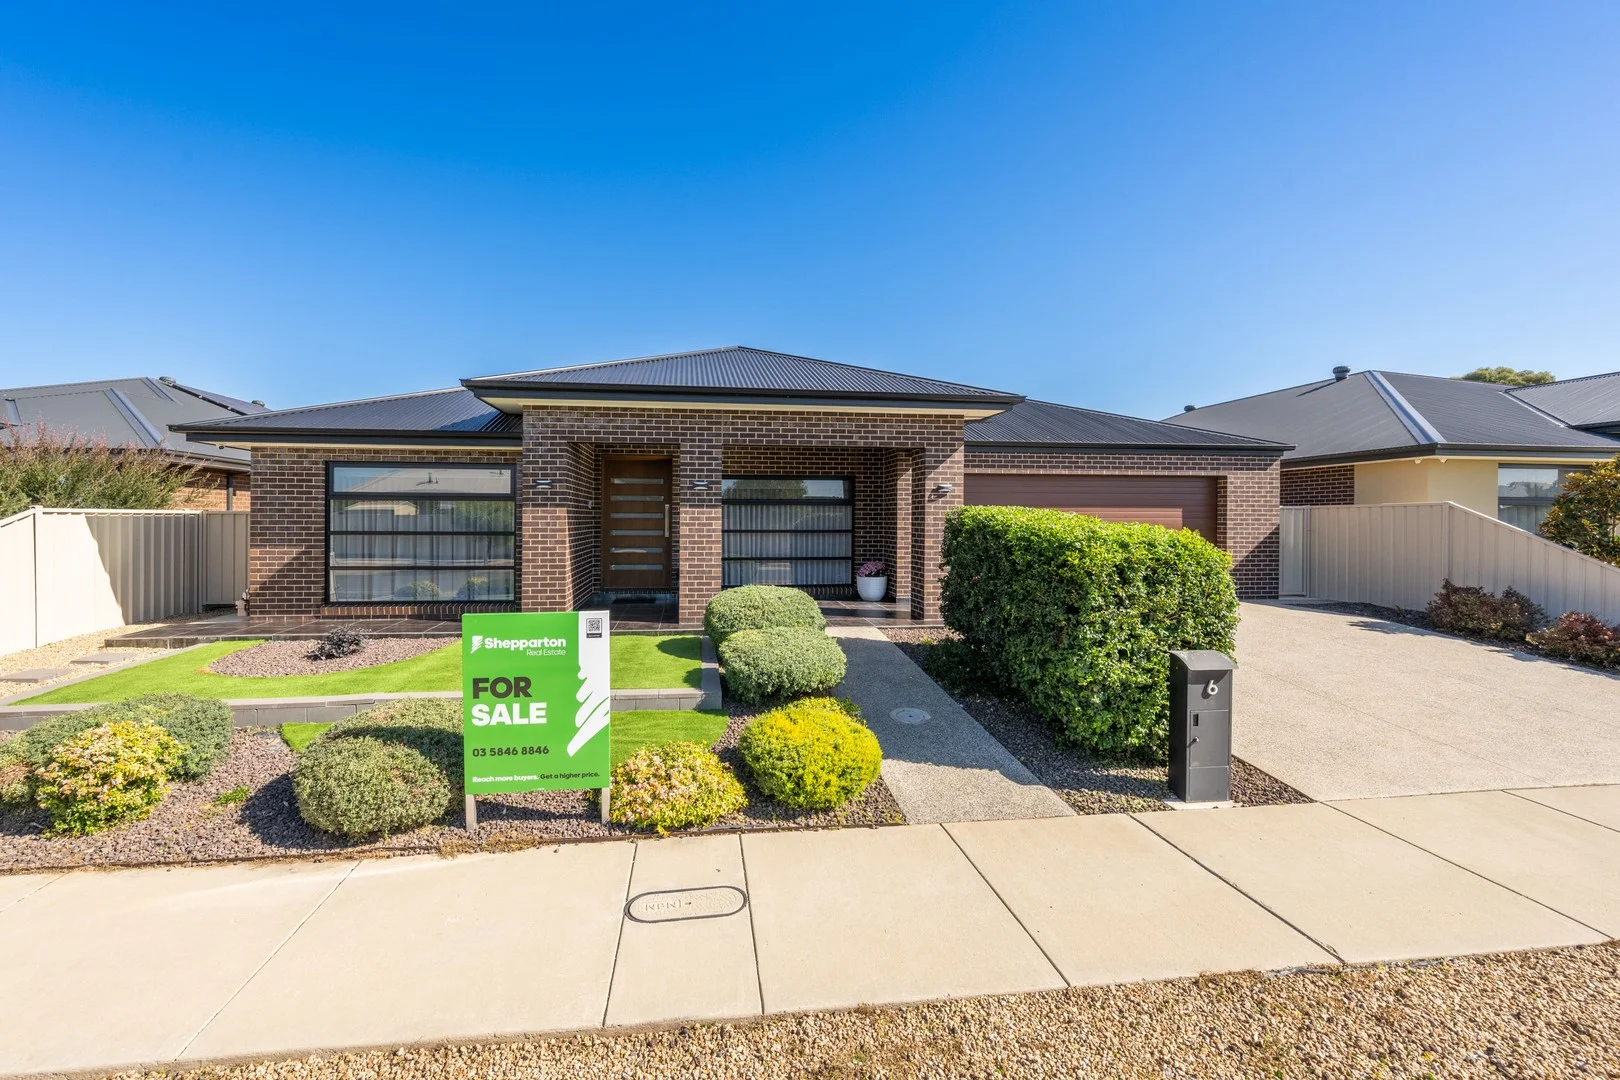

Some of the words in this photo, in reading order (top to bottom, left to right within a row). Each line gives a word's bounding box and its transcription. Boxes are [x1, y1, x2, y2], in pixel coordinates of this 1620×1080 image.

[484, 637, 566, 651] Shepparton
[472, 676, 532, 699] FOR
[1207, 679, 1218, 695] 6
[471, 702, 547, 726] SALE
[472, 748, 486, 757] 03
[489, 746, 518, 756] 5846
[521, 745, 549, 755] 8846
[514, 774, 539, 782] buyers.
[559, 772, 580, 780] higher
[581, 771, 600, 779] price.
